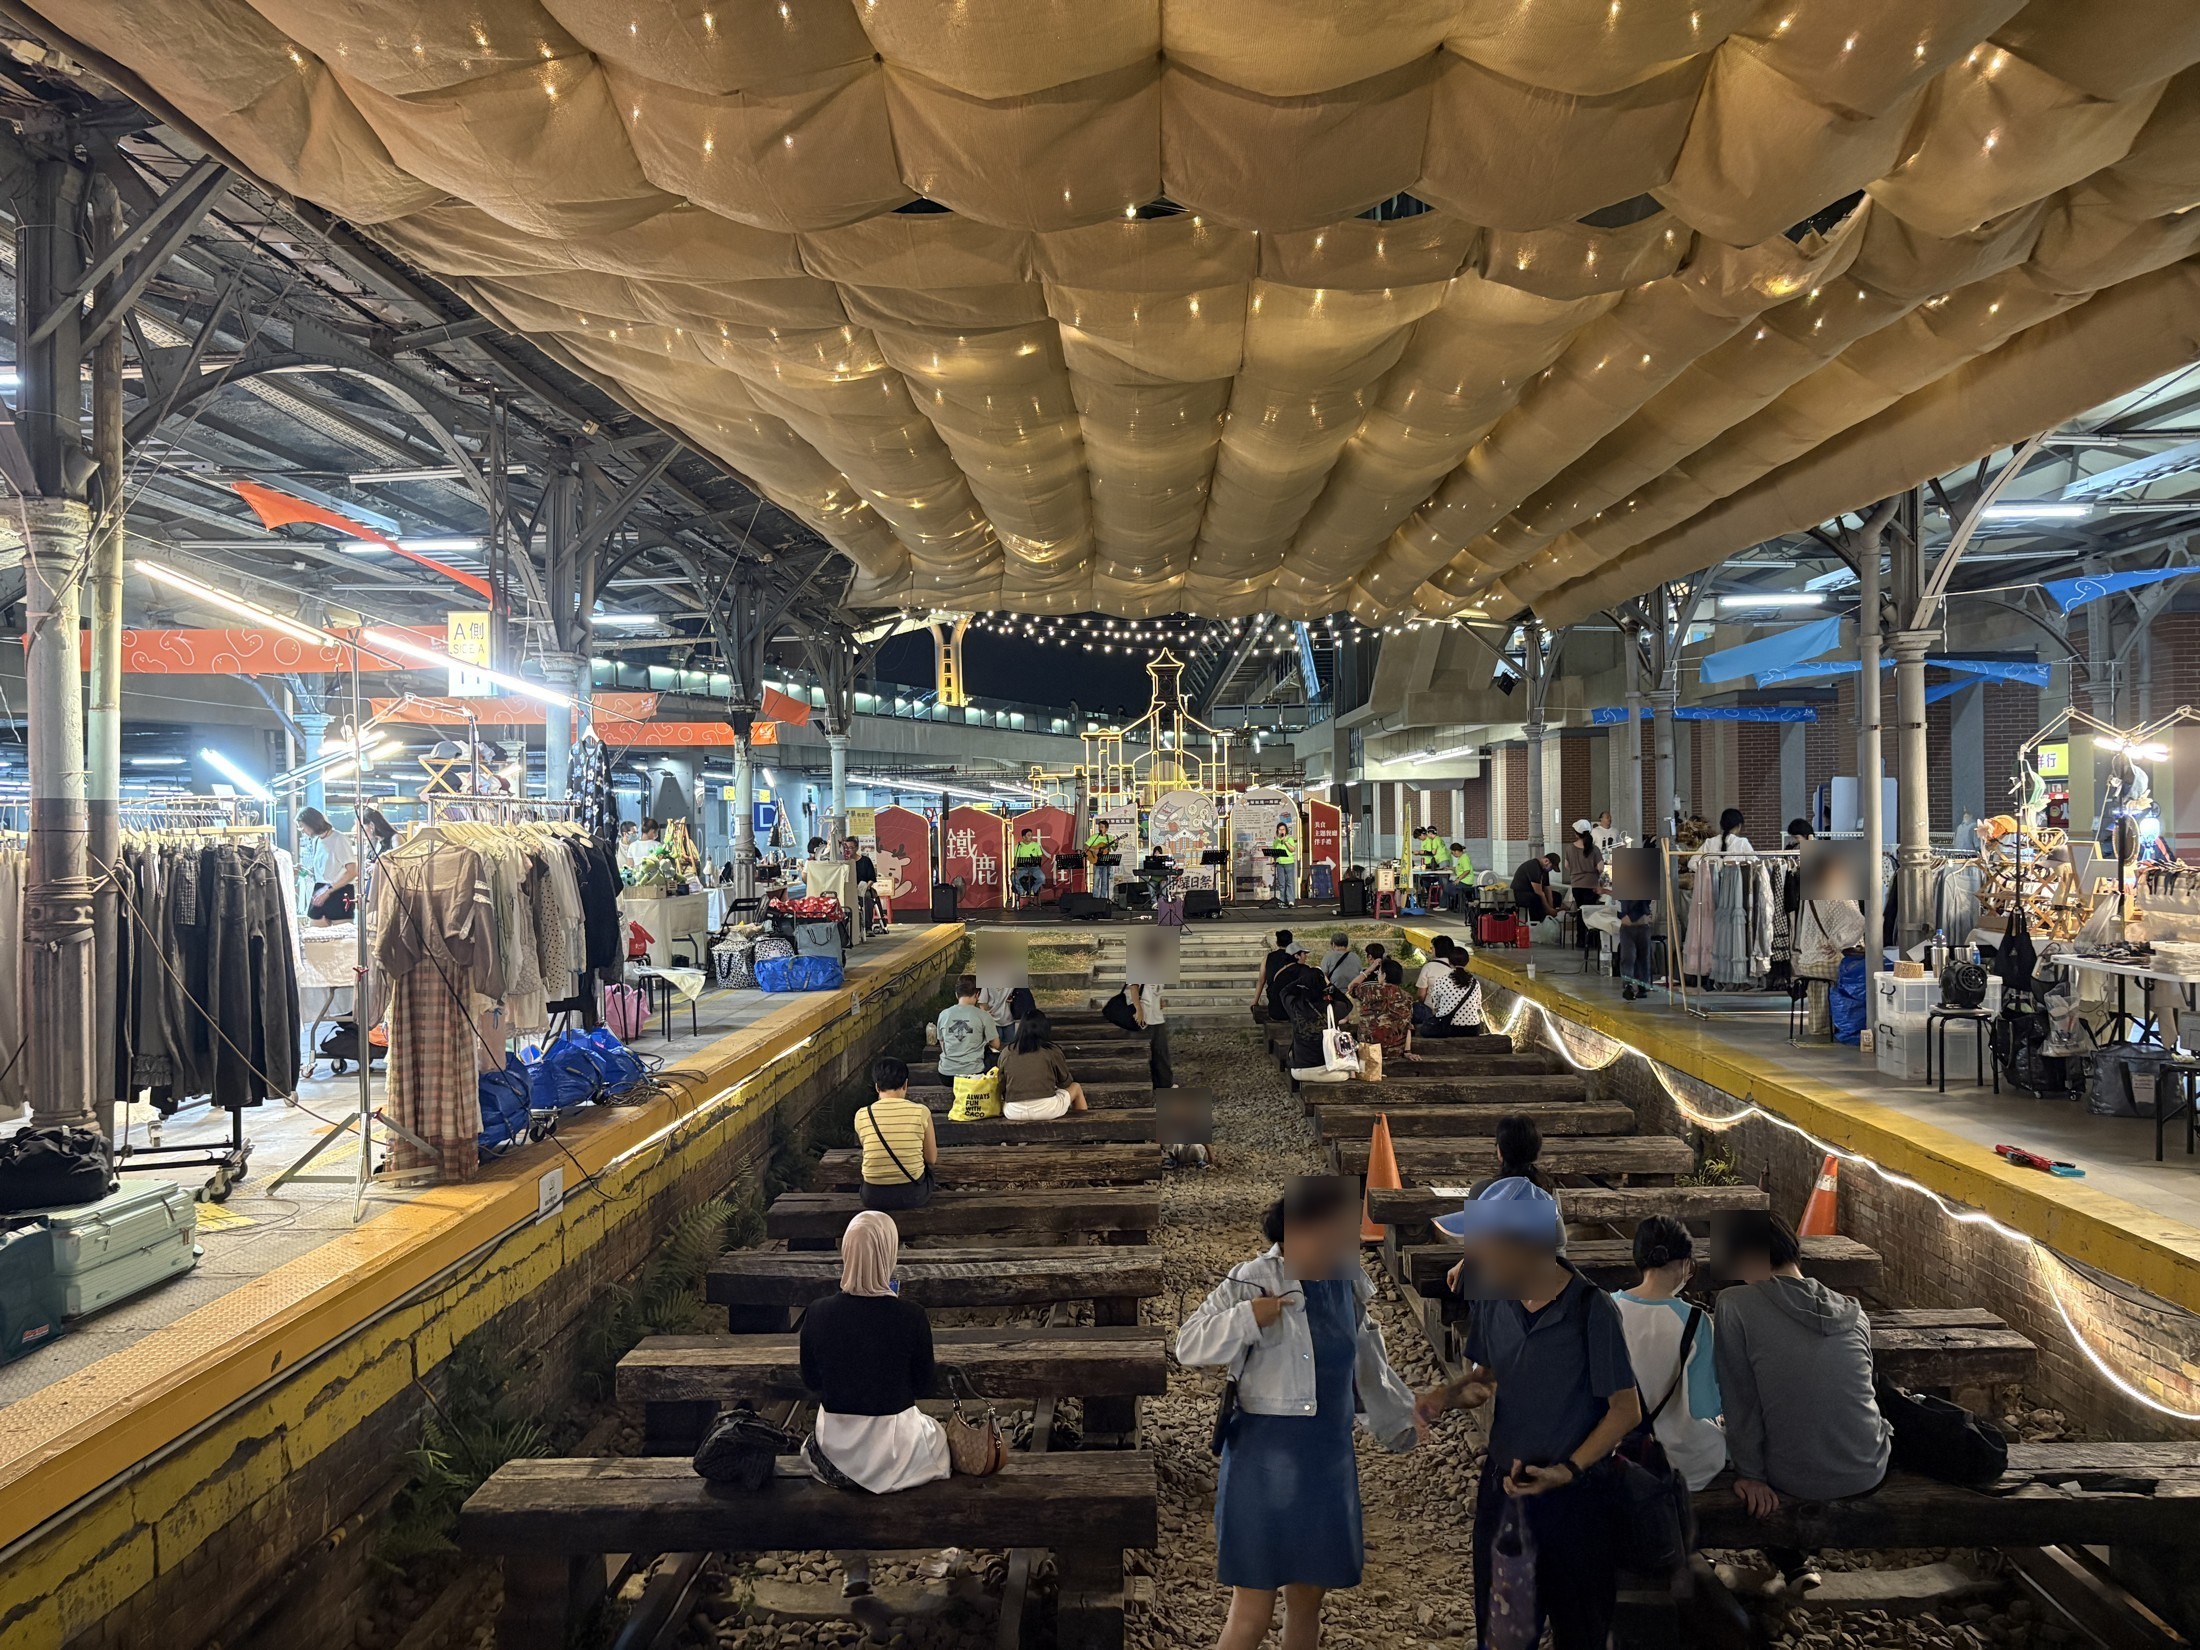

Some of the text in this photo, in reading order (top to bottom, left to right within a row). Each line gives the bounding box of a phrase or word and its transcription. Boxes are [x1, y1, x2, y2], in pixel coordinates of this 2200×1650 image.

[479, 644, 485, 654] A
[760, 804, 778, 828] D
[1314, 838, 1332, 846] 伴手禮
